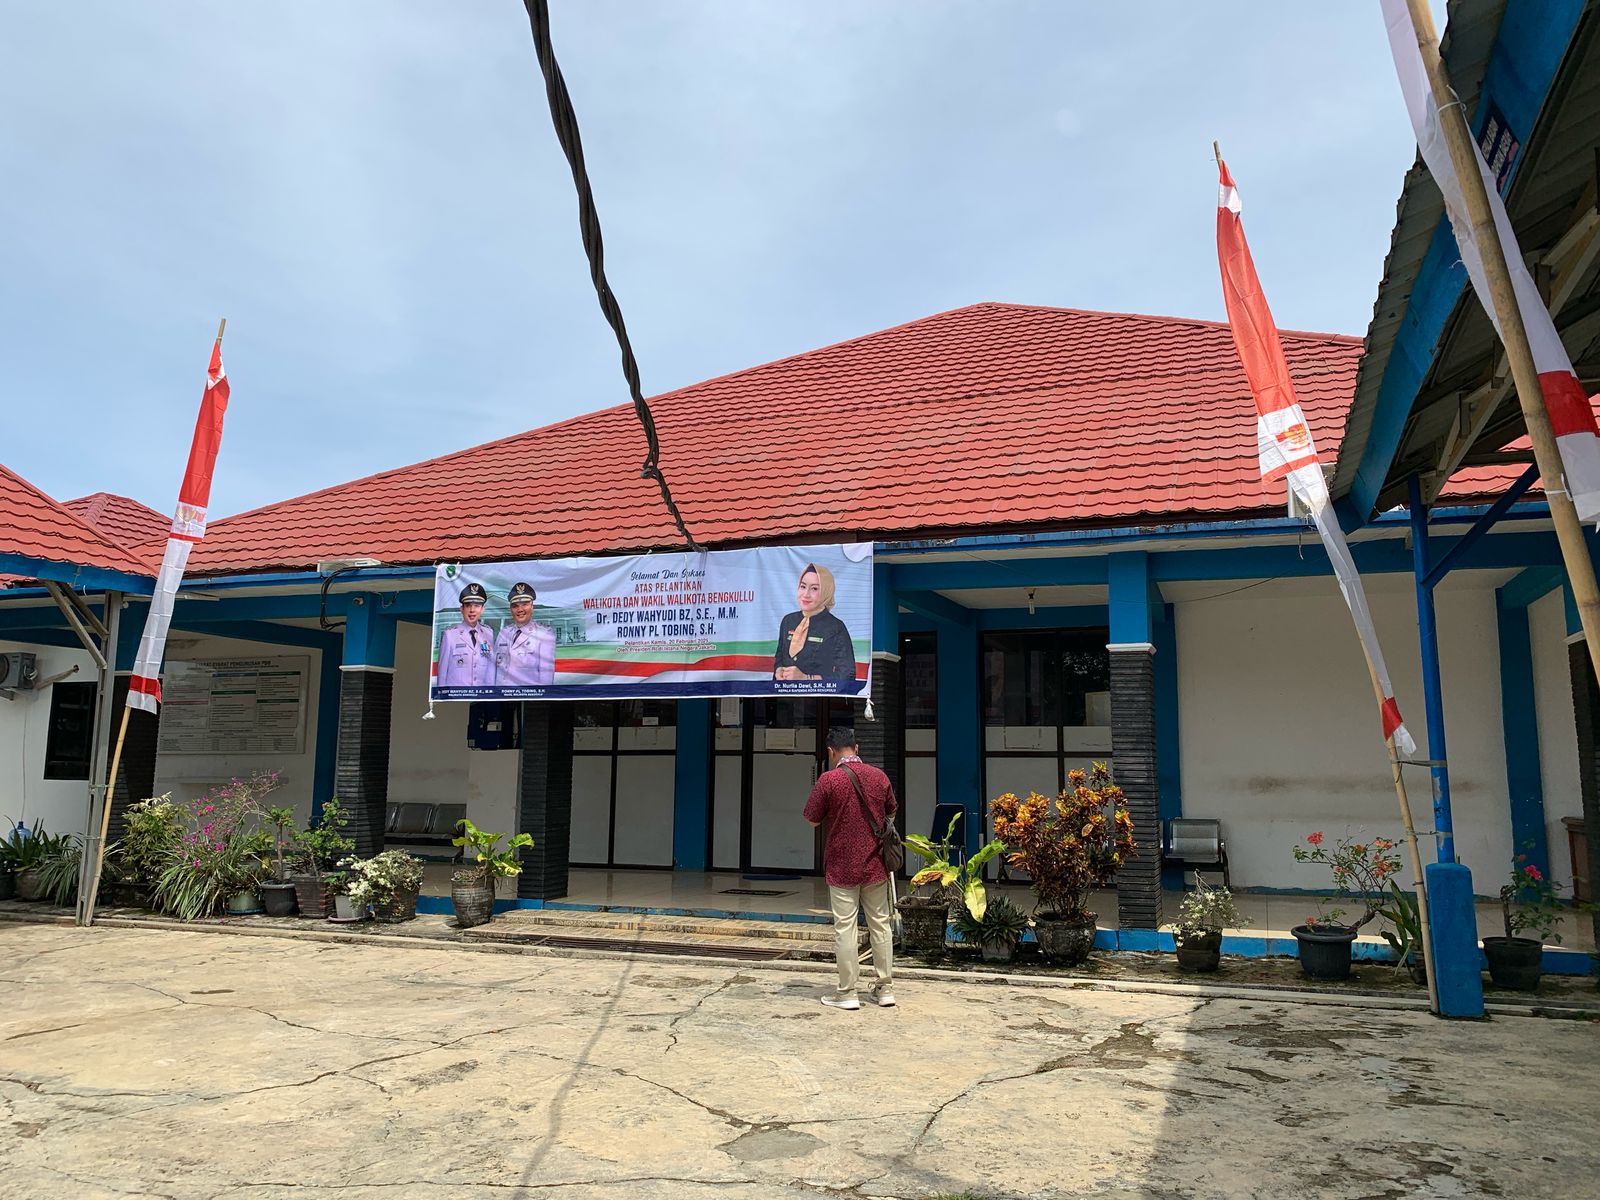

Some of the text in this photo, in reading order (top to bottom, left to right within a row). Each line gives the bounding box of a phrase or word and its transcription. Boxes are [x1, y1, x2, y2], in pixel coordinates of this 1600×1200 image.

[630, 568, 706, 581] Selamat Dan Sukses
[635, 580, 702, 593] ATAS PELANTIKAN
[583, 590, 754, 609] WALIKOTA DAN WAKIL WALIKOTA BENGKULLU
[596, 606, 739, 624] Dr. DEDY WAHYUDI BZ, S.E., M.M.
[617, 622, 716, 638] RONNY PL TOBING, S.H.
